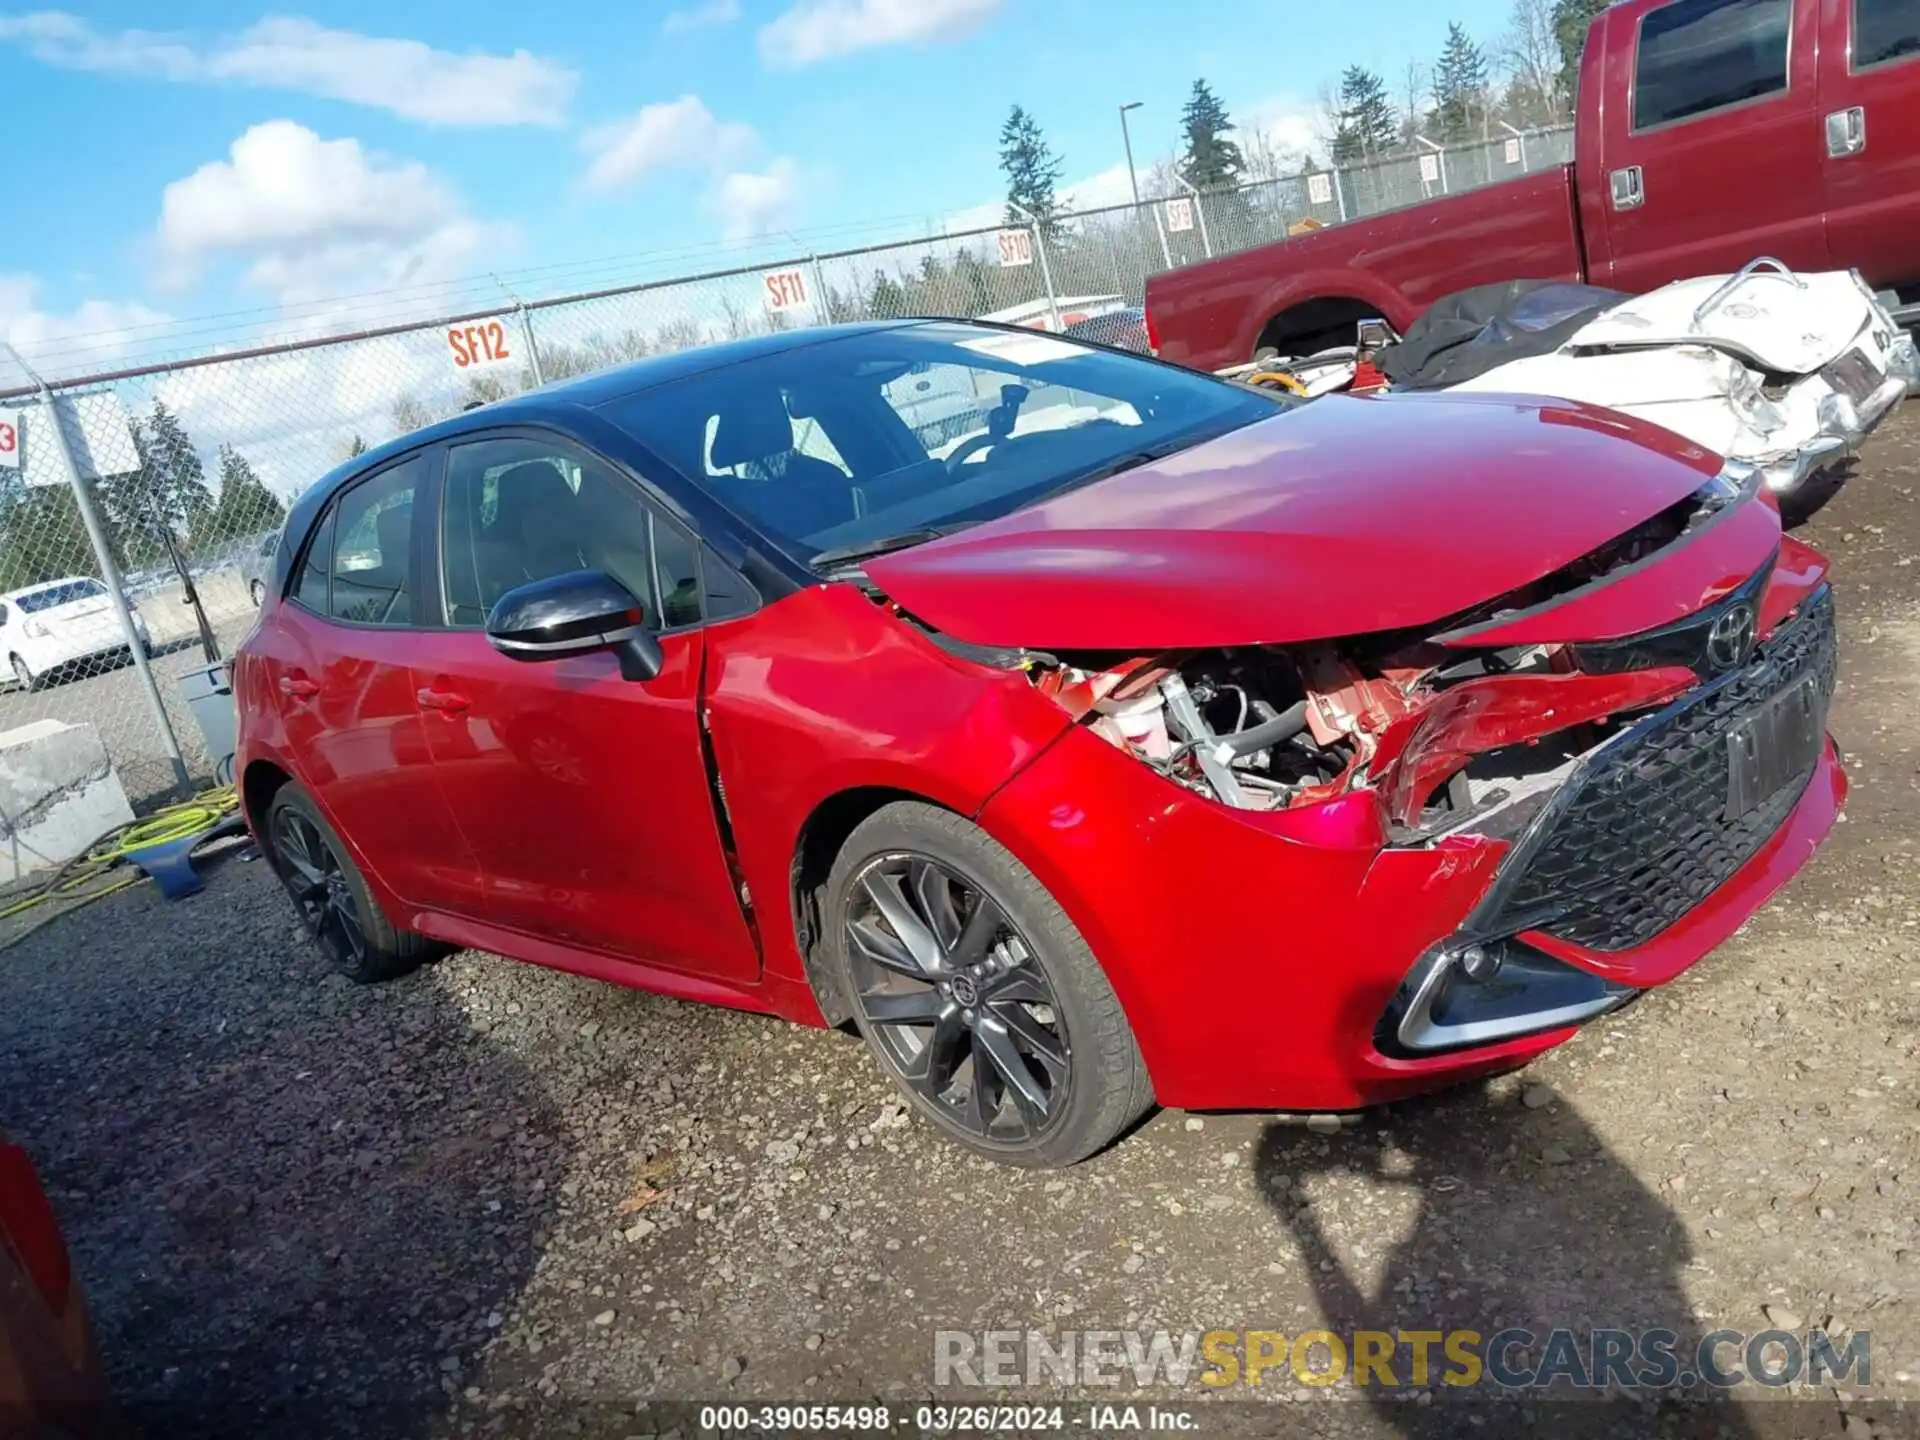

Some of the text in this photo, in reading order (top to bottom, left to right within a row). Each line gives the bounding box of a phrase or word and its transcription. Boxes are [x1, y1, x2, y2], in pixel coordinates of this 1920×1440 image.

[998, 234, 1030, 261] SF10
[766, 272, 806, 307] SF11
[448, 322, 509, 368] SF12
